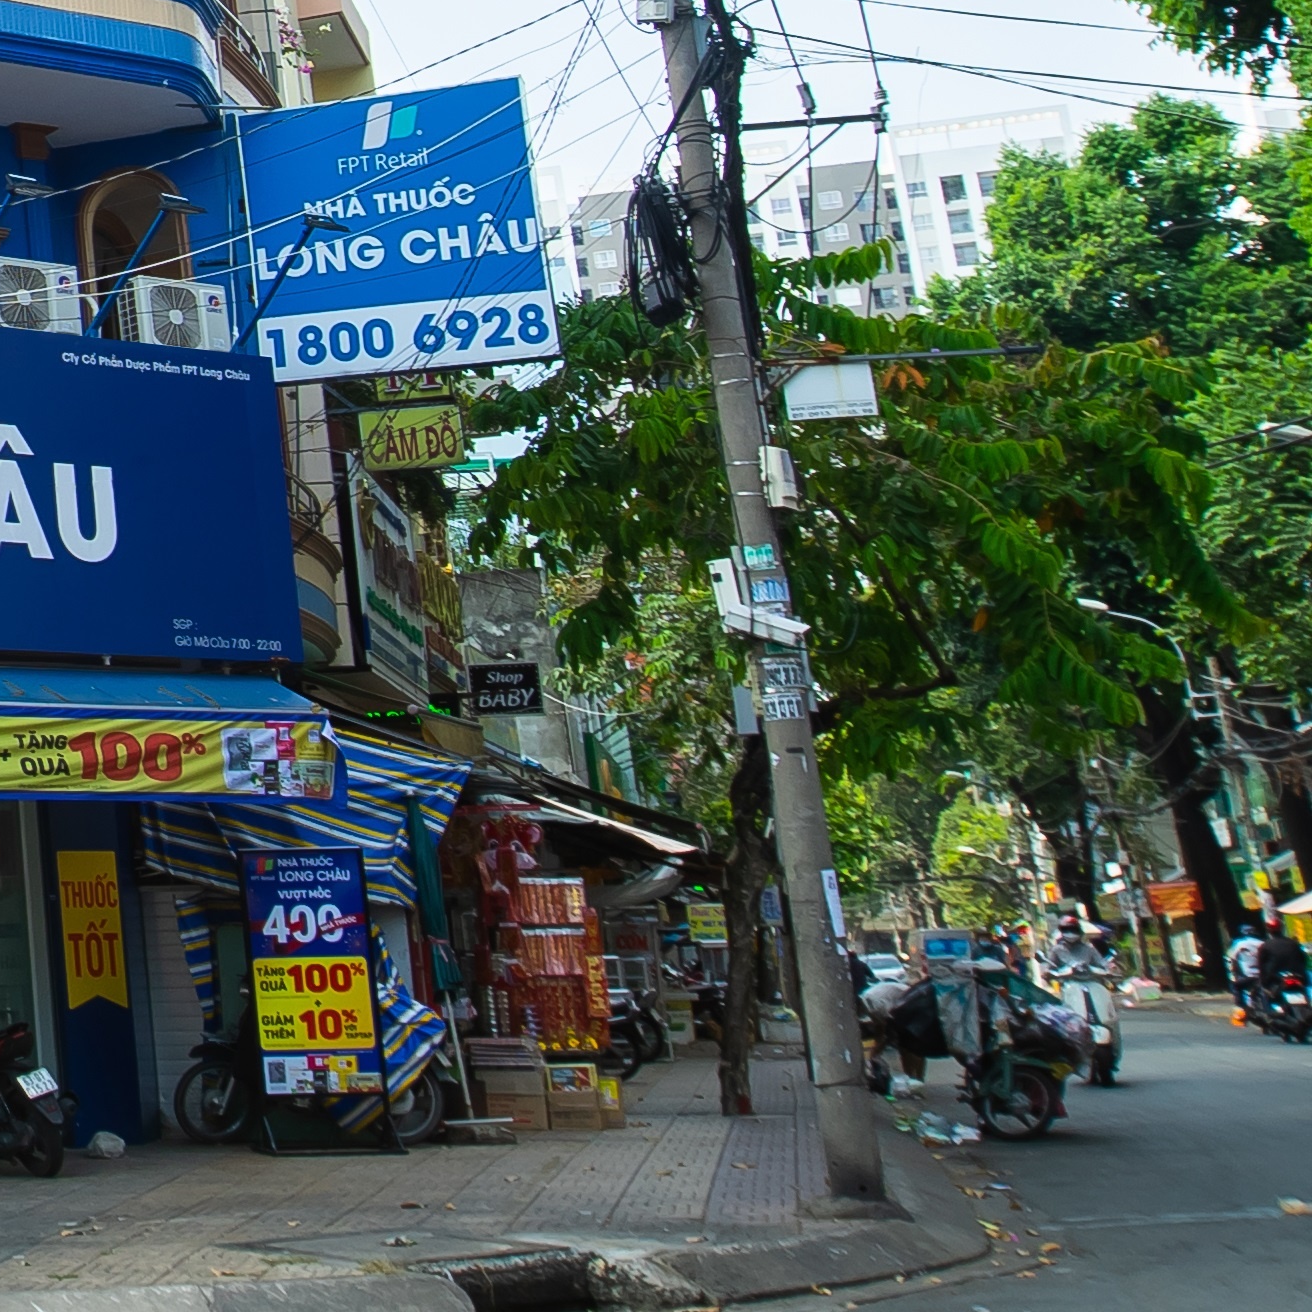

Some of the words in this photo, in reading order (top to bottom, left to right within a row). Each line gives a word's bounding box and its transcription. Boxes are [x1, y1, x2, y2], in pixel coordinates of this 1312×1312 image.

[337, 155, 371, 175] FPT
[375, 148, 429, 171] Retail
[303, 191, 366, 219] NHÀ
[372, 176, 476, 214] THUỐC
[256, 235, 385, 282] LONG
[399, 212, 540, 265] CHÂU
[266, 318, 394, 369] 1800
[413, 303, 550, 355] 6928
[125, 358, 151, 373] Dược
[182, 364, 198, 376] FPT
[199, 366, 223, 381] Long
[224, 368, 251, 382] Châu
[486, 670, 524, 686] Shop
[478, 688, 536, 708] BABY
[13, 729, 68, 754] TẶNG
[19, 753, 71, 777] QUÀ
[67, 730, 207, 783] 100%
[300, 855, 334, 868] THUỐC
[279, 870, 314, 883] LONG
[316, 869, 351, 882] CHÂU
[60, 873, 119, 910] THUỐC
[277, 889, 308, 902] VƯỢT
[308, 887, 332, 900] MỐC
[262, 903, 344, 944] 400
[68, 921, 120, 979] TỐT
[256, 965, 286, 981] TẶNG
[259, 975, 288, 992] QUÀ
[287, 962, 365, 993] 100%
[261, 1011, 295, 1027] GIẢM
[263, 1026, 296, 1040] THÊM
